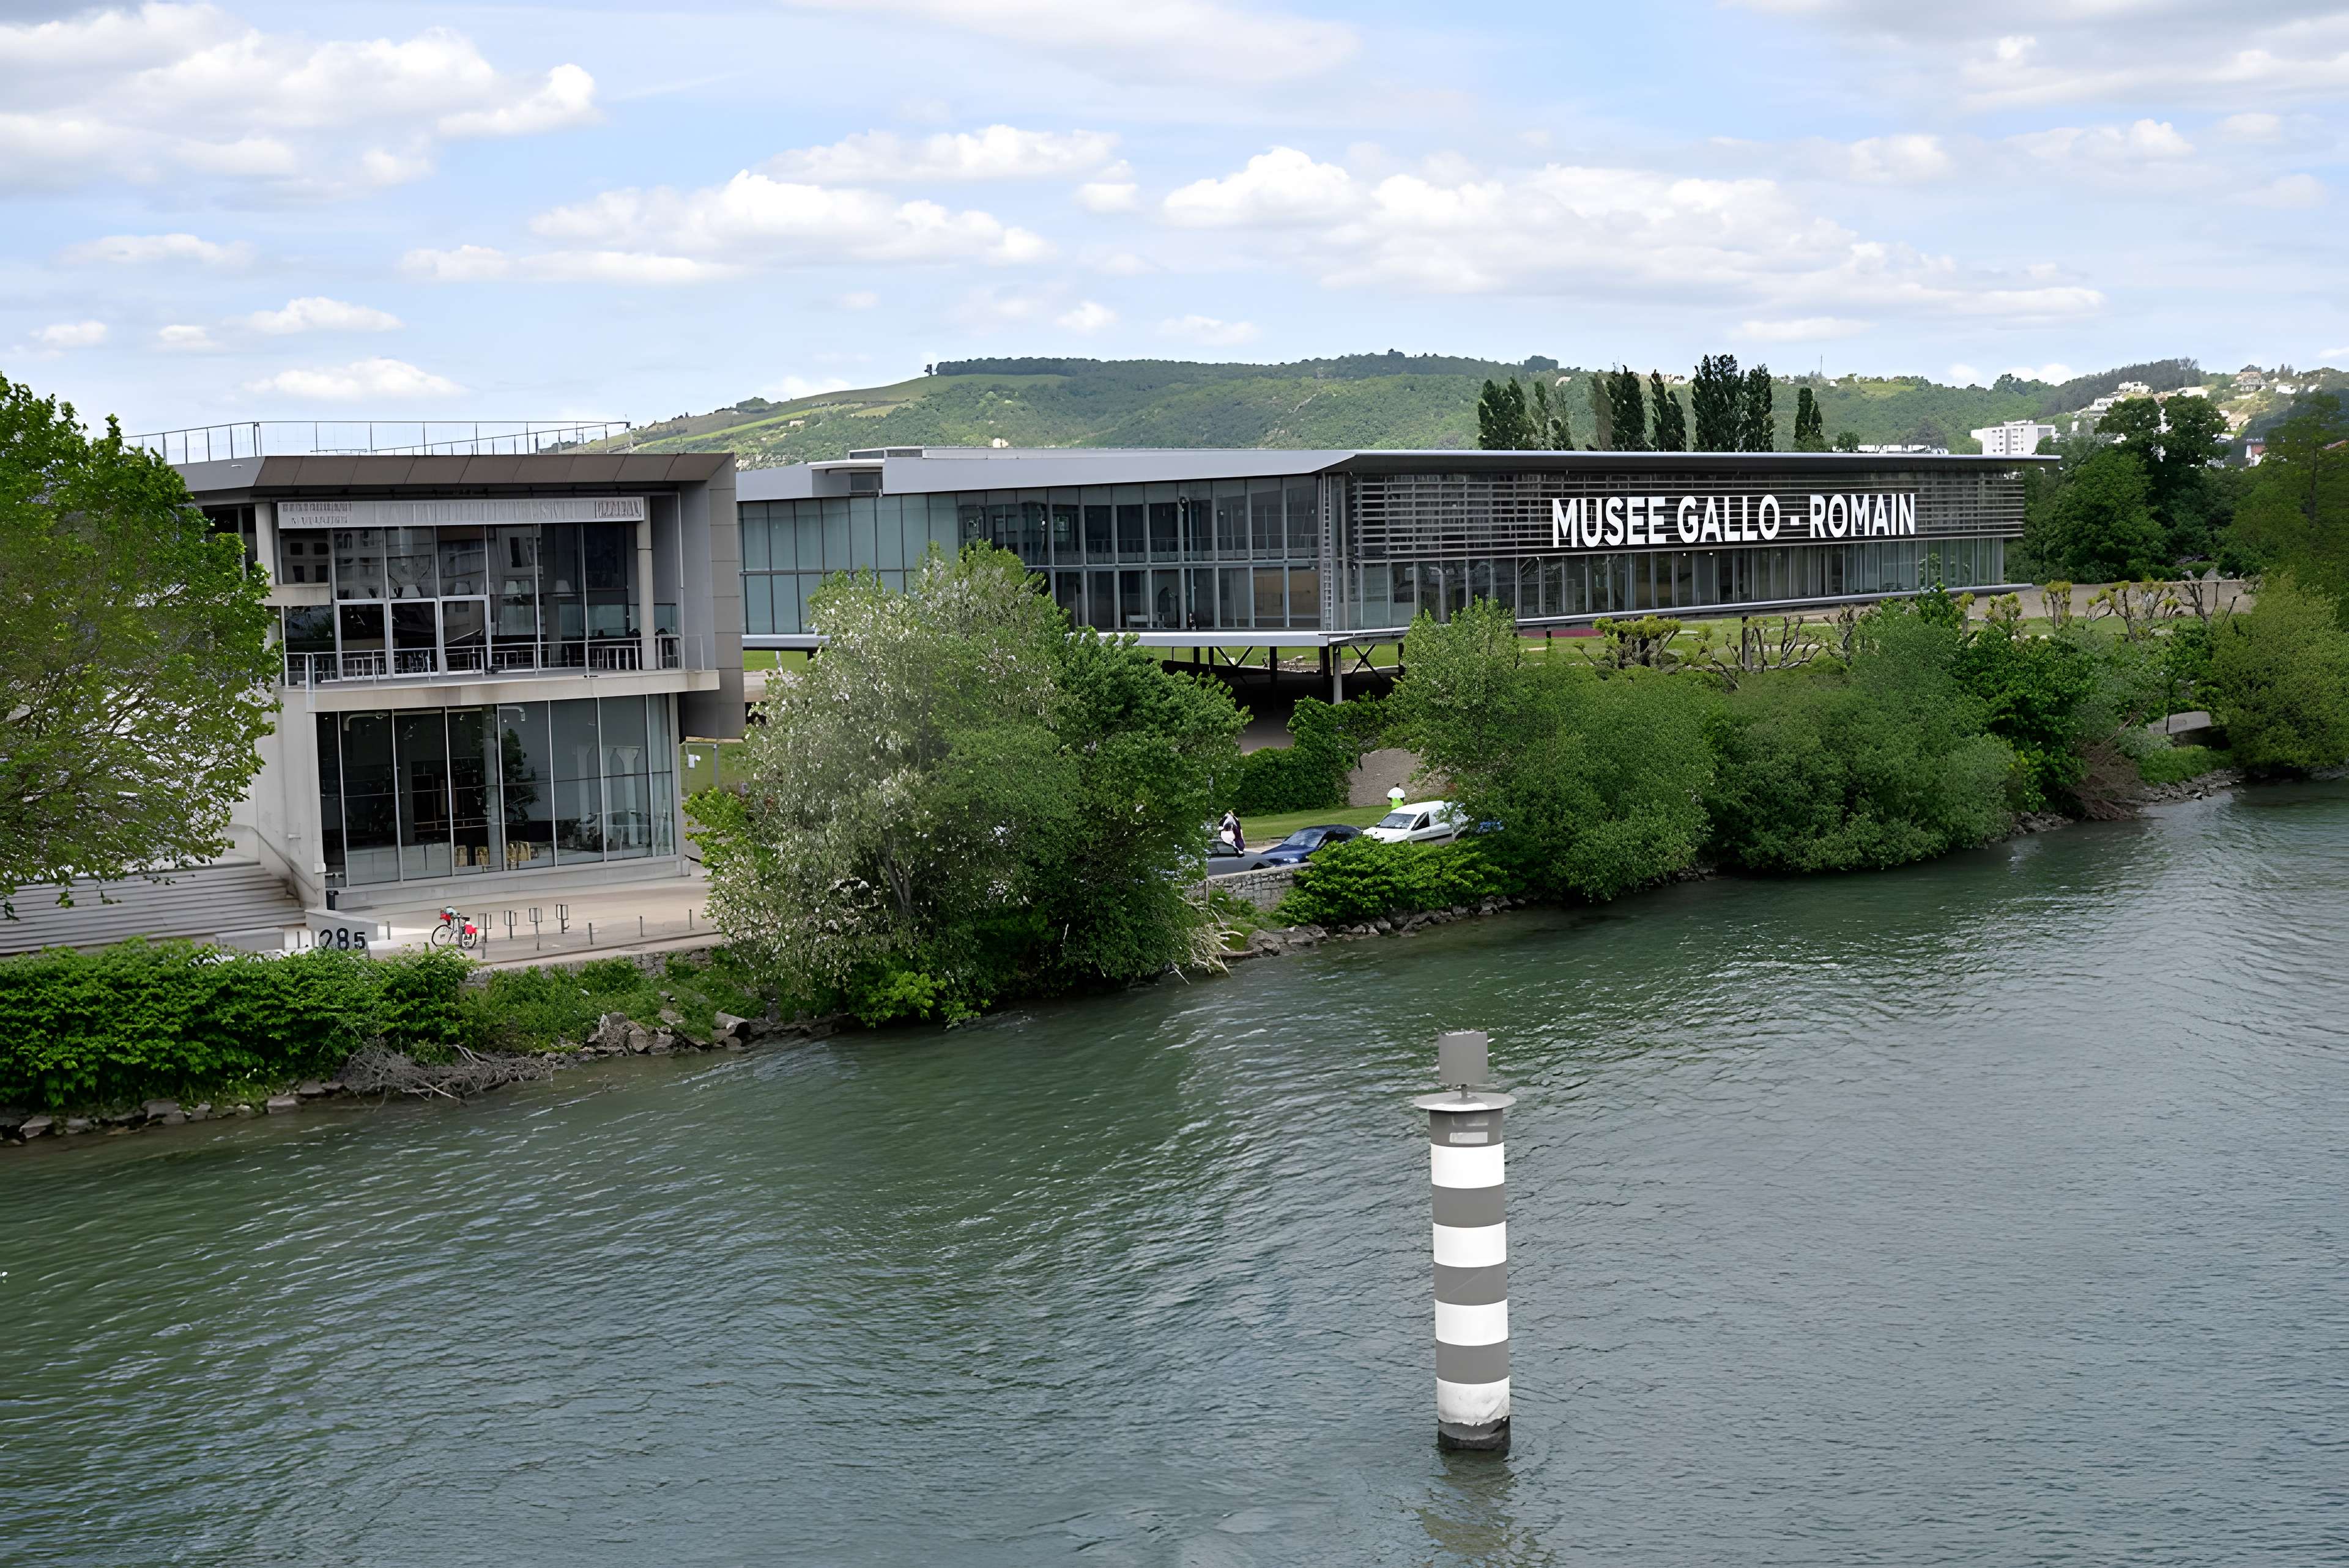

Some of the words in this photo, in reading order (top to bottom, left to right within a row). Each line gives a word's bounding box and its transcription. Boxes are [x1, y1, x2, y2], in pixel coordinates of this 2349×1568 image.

[1552, 496, 1666, 548] MUSEE
[1677, 494, 1780, 544] GALLO
[1810, 494, 1915, 538] ROMAIN
[319, 928, 366, 950] 285
